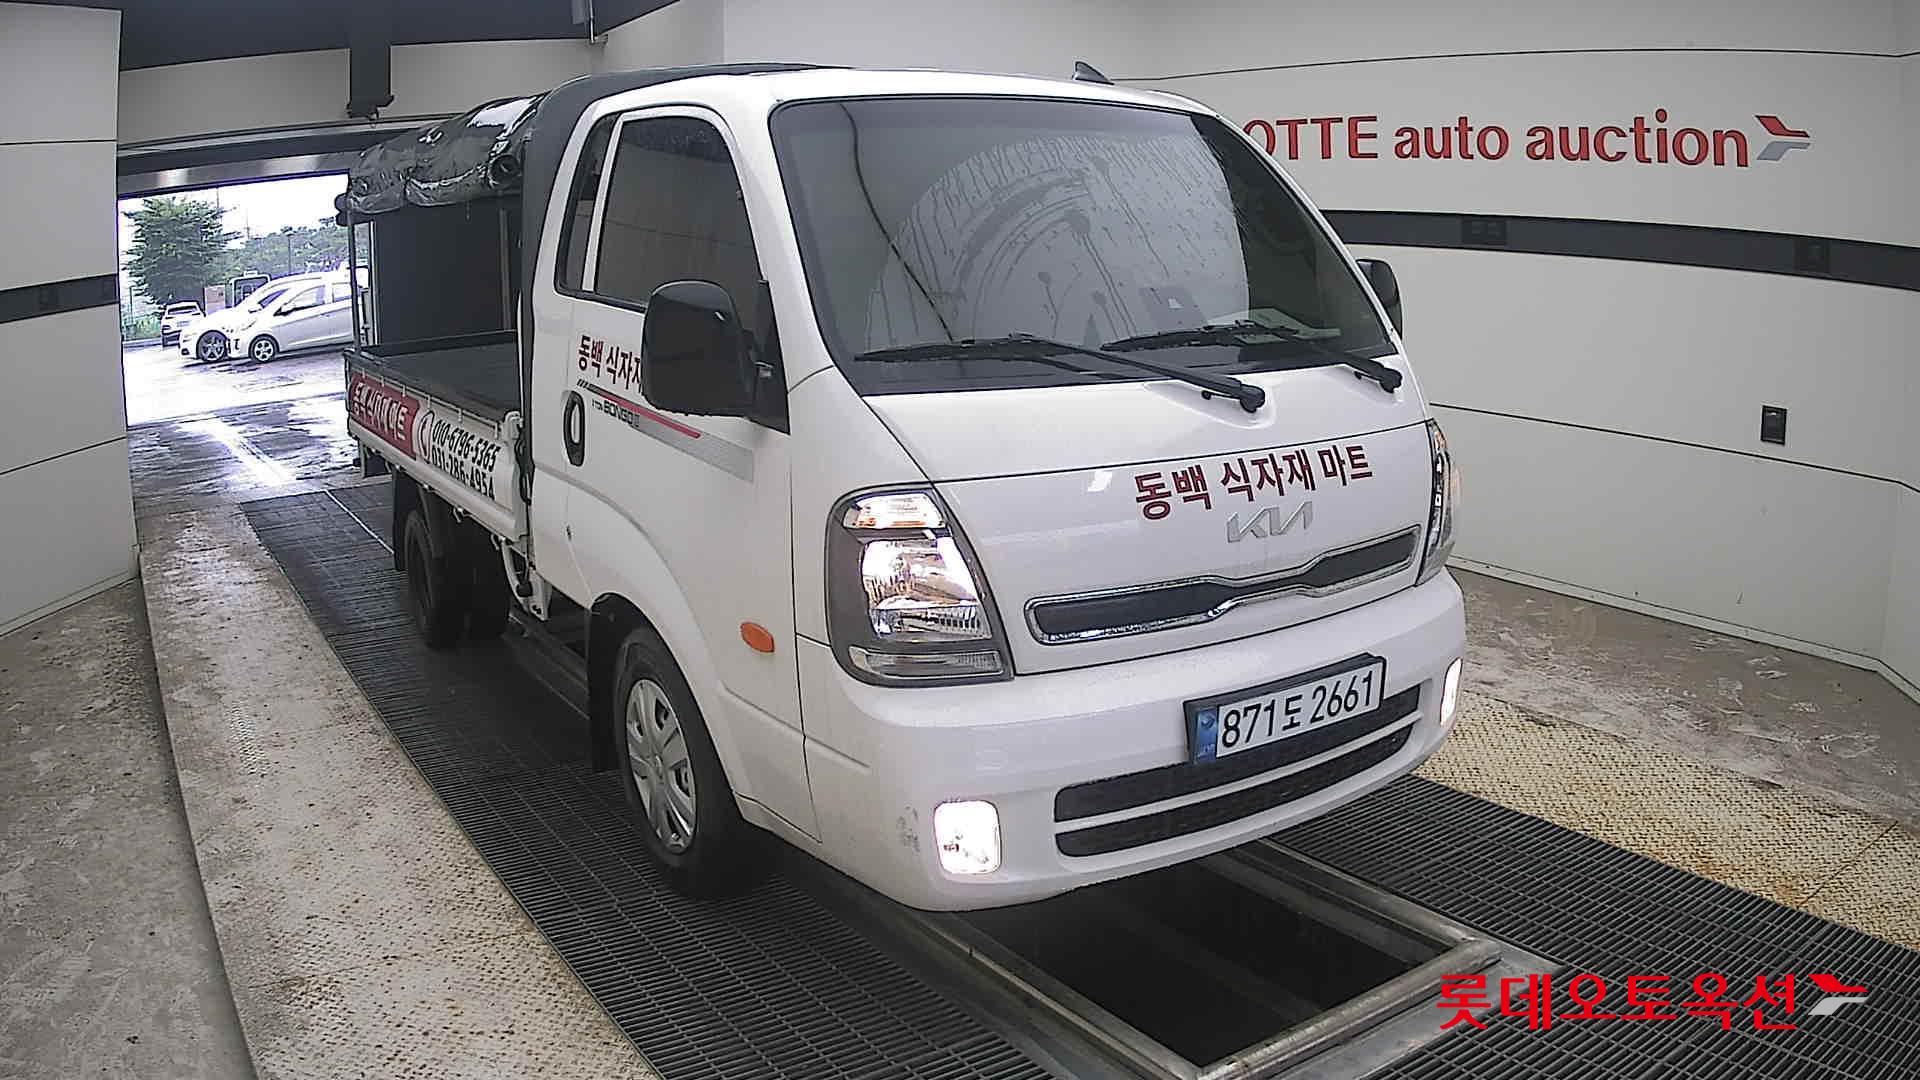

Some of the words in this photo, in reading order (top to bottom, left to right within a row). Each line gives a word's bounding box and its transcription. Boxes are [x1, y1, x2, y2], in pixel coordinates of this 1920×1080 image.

[1243, 115, 1378, 160] OTTE
[1394, 115, 1510, 161] auto
[1525, 108, 1748, 167] auction
[578, 335, 604, 378] 동백
[1134, 464, 1212, 520] 동백
[1220, 449, 1316, 502] 식자재
[1317, 445, 1373, 486] 마트
